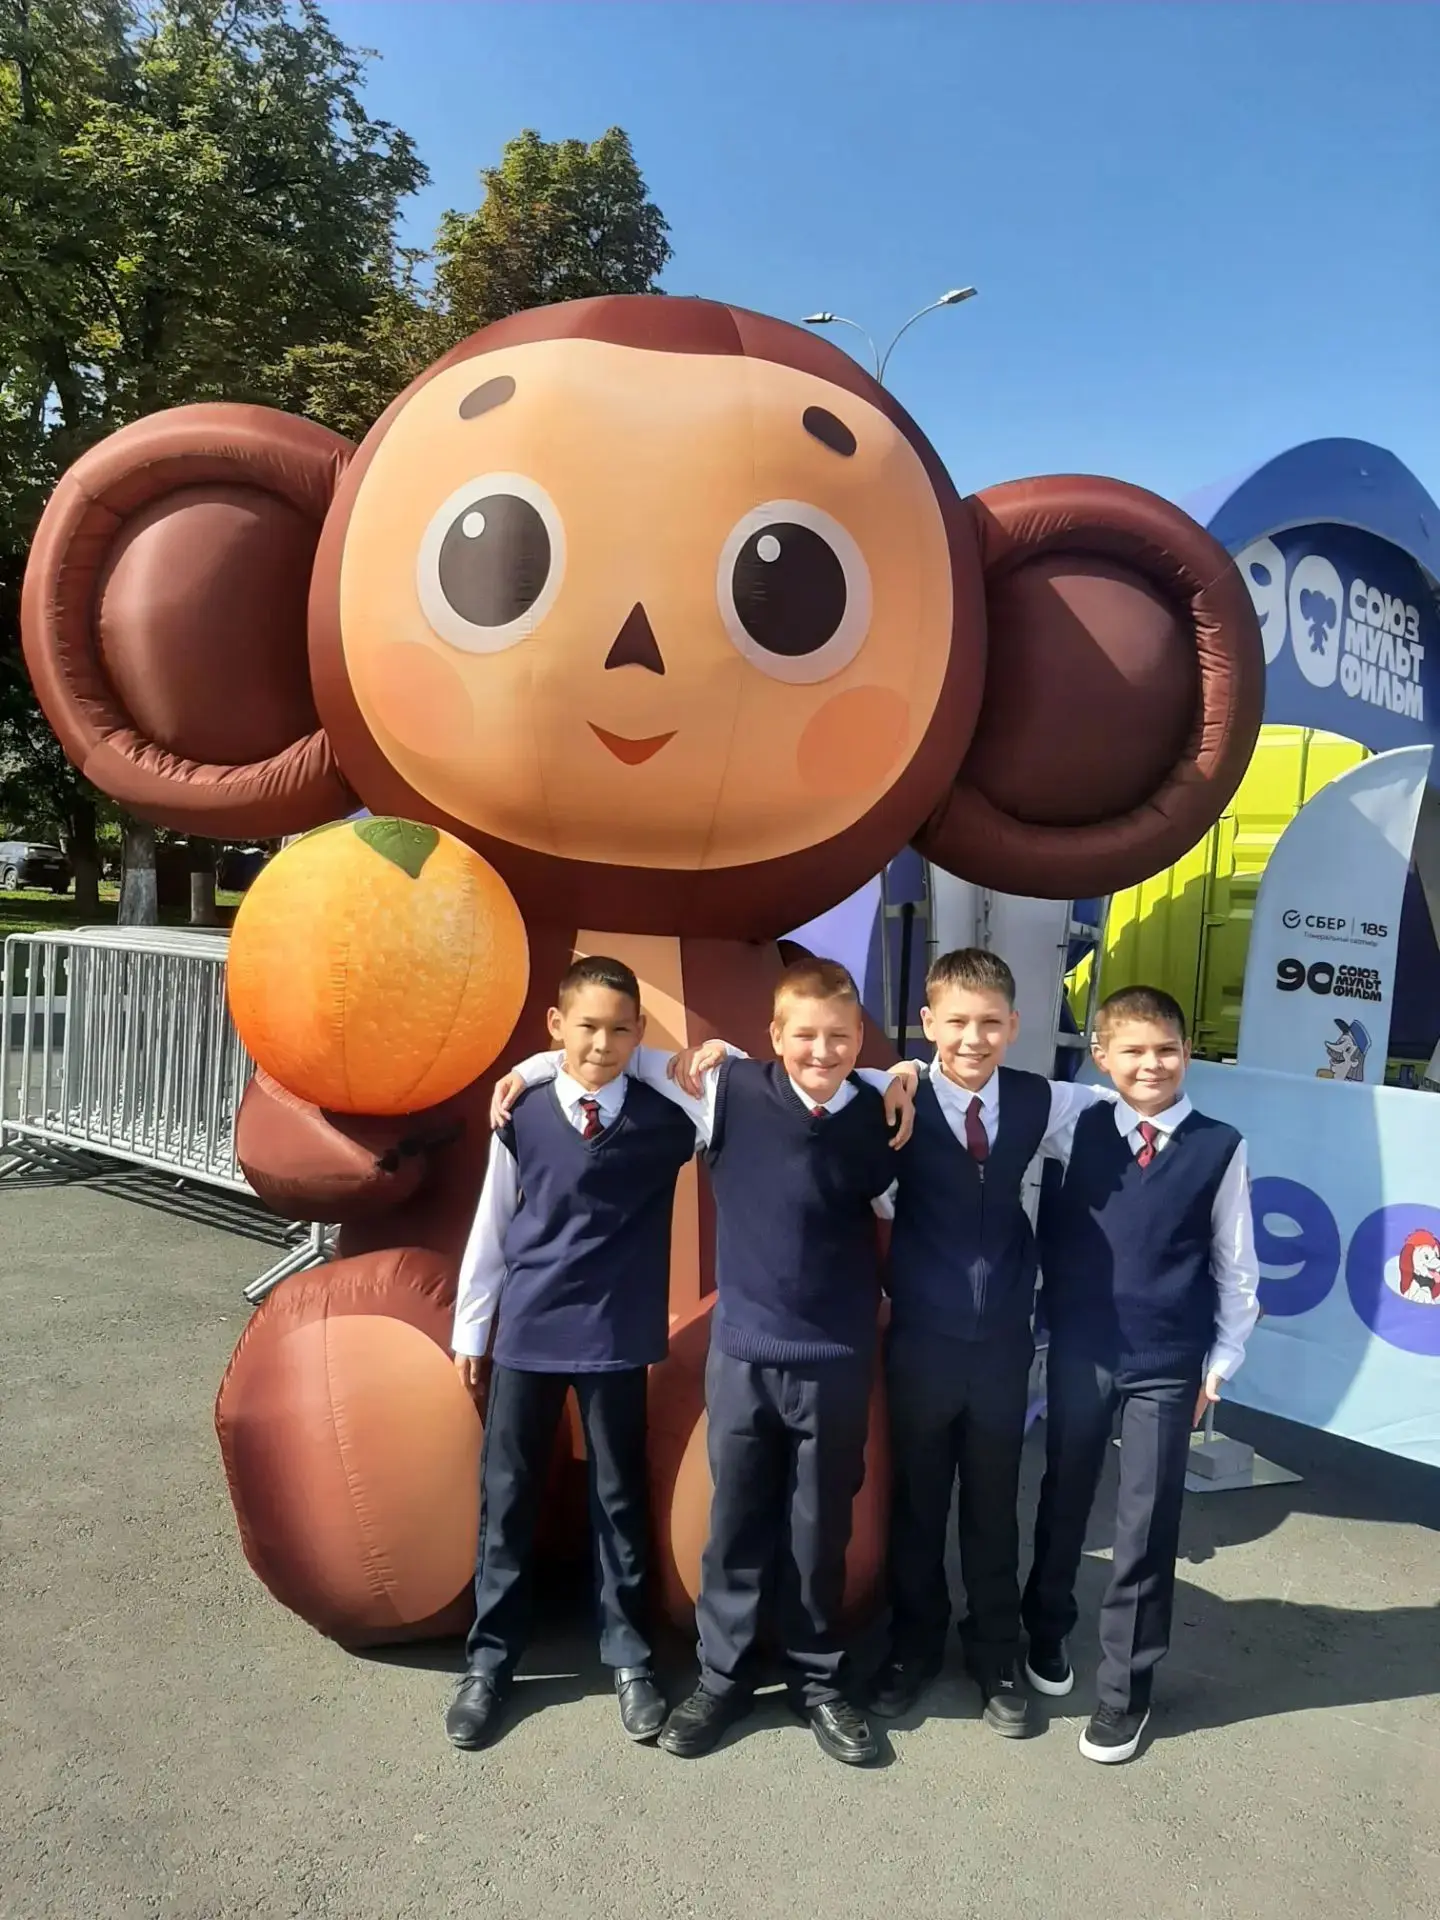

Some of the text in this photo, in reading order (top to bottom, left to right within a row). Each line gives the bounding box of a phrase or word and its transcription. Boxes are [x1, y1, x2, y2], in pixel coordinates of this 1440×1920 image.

[1234, 538, 1344, 687] 90
[1350, 578, 1420, 643] СОЮЗ
[1345, 618, 1424, 683] МУЛЬТ
[1340, 654, 1424, 722] ФИЛЬМ
[1305, 915, 1388, 938] СБЕР 185
[1276, 958, 1335, 995] 90
[1335, 975, 1382, 991] МУЛЬТ
[1339, 964, 1379, 979] СОЮЗ
[1333, 985, 1382, 1002] ФИЛЬМ
